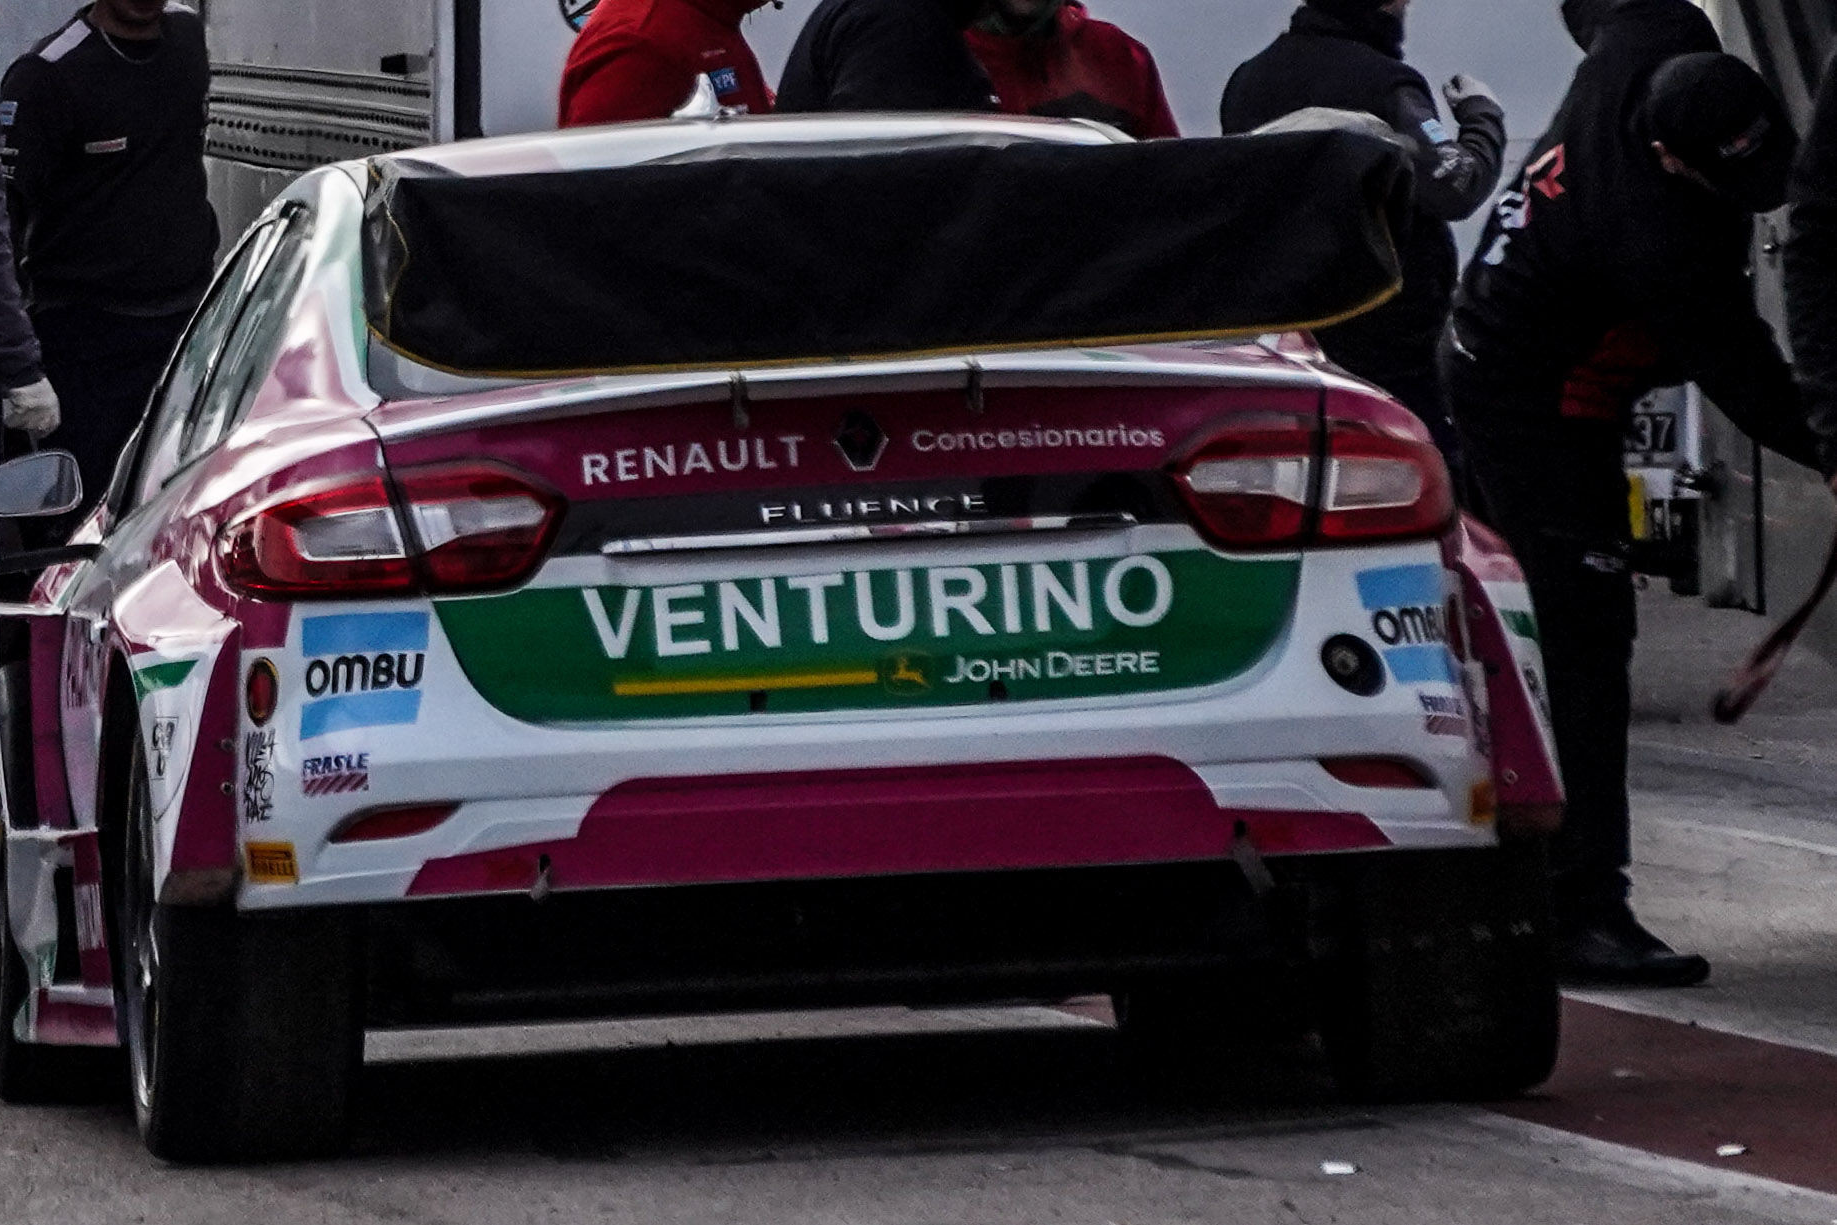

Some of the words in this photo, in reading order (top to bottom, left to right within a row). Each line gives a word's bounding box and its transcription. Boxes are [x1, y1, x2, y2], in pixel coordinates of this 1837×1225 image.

[582, 434, 806, 486] RENAULT
[911, 422, 1166, 453] Concesionarios
[760, 492, 988, 525] FLUENCE
[582, 554, 1174, 660] VENTURINO
[306, 652, 425, 698] OMBU
[943, 653, 1042, 684] JOHN
[1047, 650, 1162, 678] DEERE
